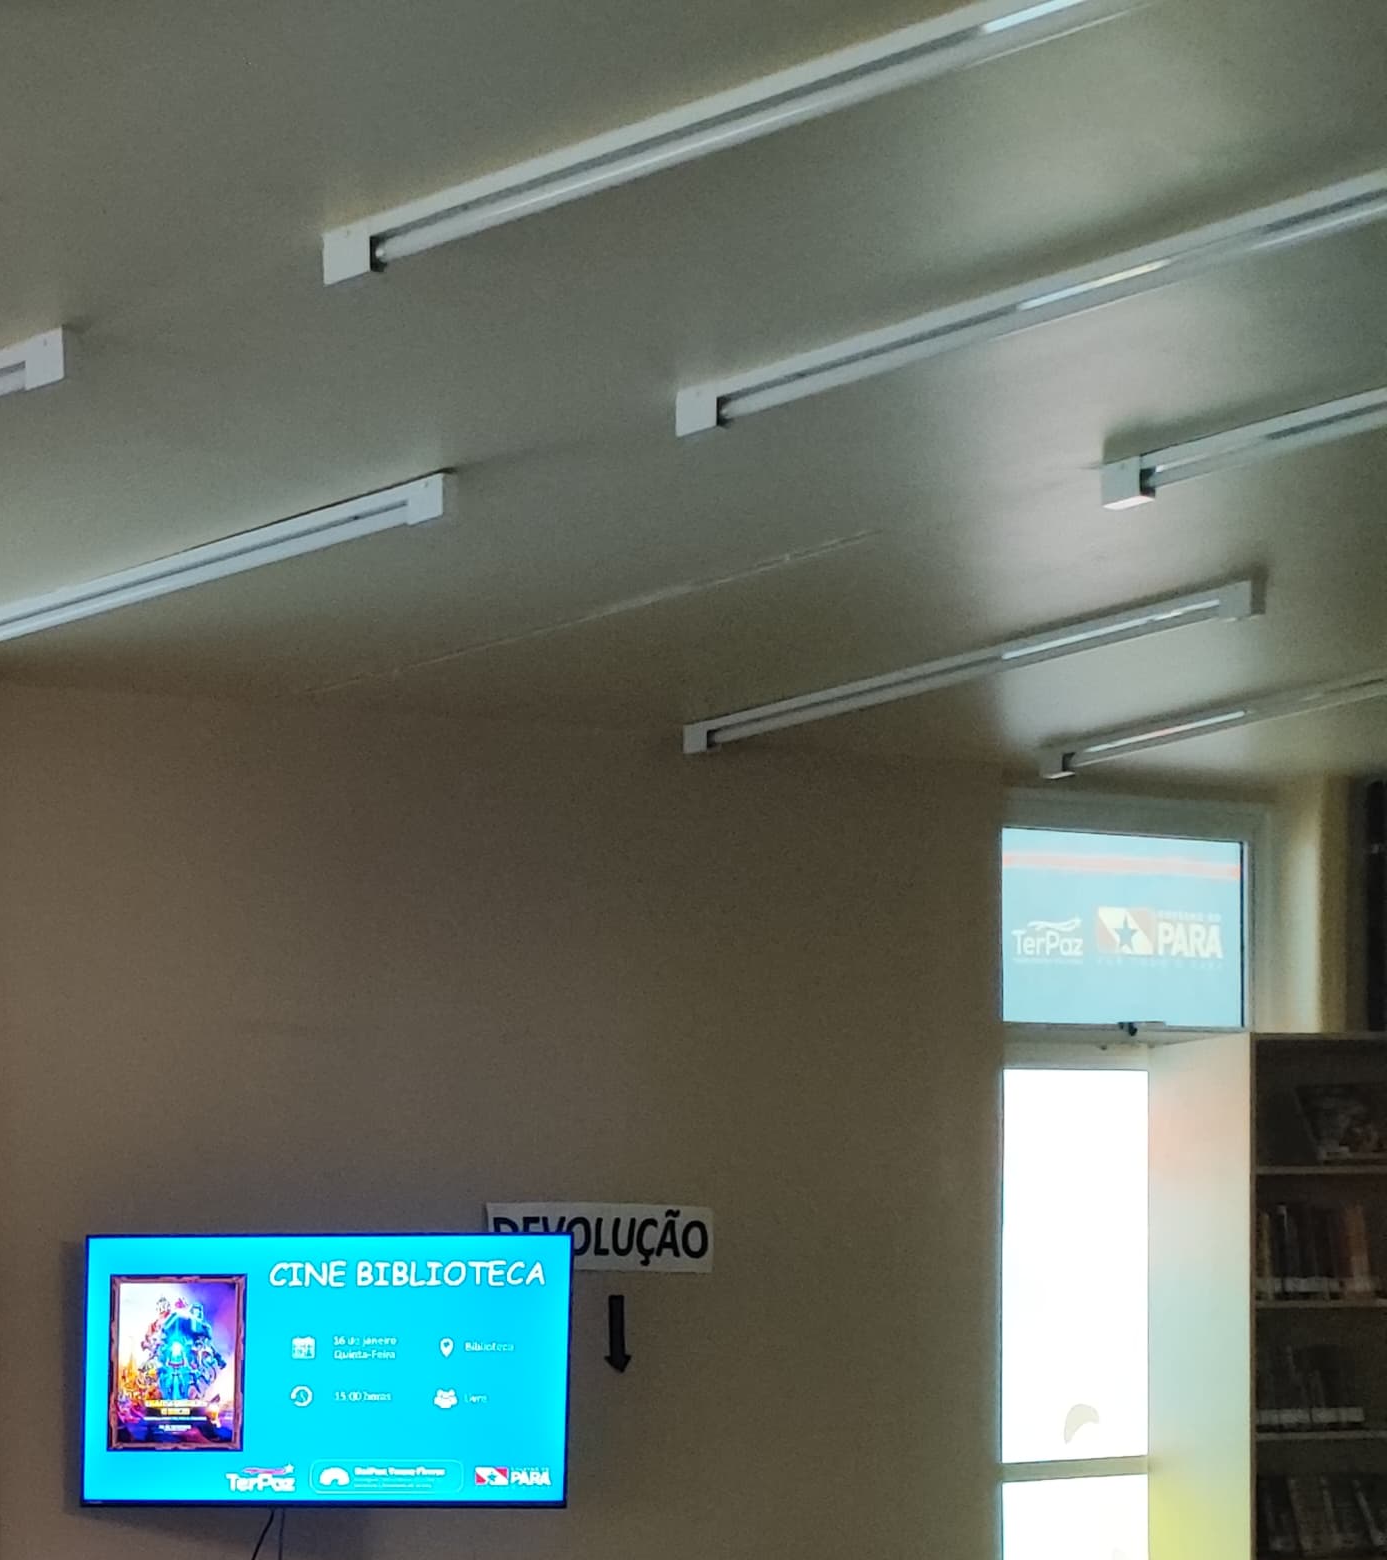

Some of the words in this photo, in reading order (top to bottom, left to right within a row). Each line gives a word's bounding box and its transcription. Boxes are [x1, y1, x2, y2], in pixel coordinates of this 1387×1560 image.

[1011, 928, 1084, 957] TerPaz
[269, 1260, 347, 1287] CINE
[356, 1260, 546, 1287] BIBLIOTECA
[225, 1473, 296, 1492] TerPaz
